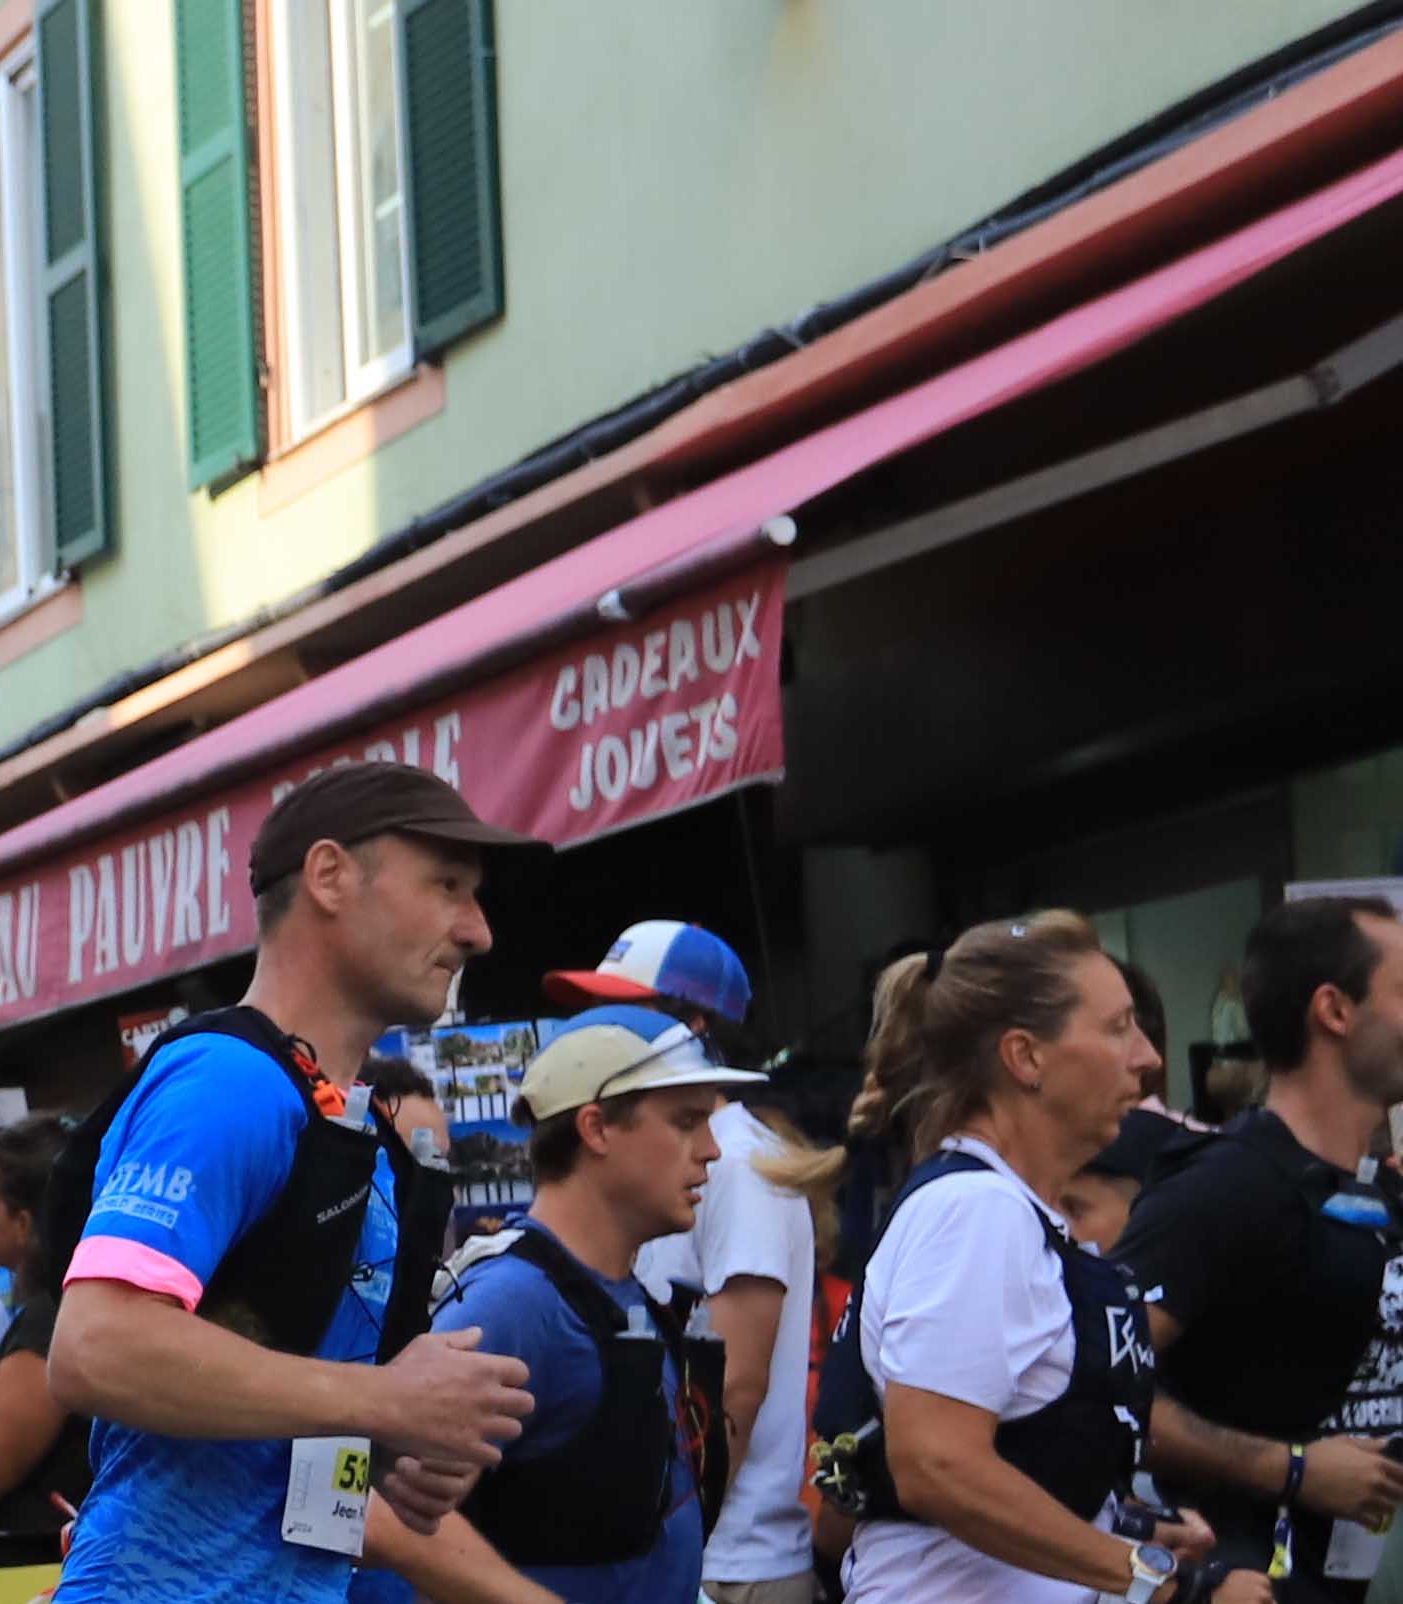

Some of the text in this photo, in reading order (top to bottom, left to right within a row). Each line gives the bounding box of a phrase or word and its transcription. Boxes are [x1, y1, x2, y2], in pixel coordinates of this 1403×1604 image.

[551, 588, 761, 731] CADEAUX
[570, 691, 739, 812] JOUETS
[67, 804, 231, 985] PAUVRE
[338, 1452, 369, 1494] 53
